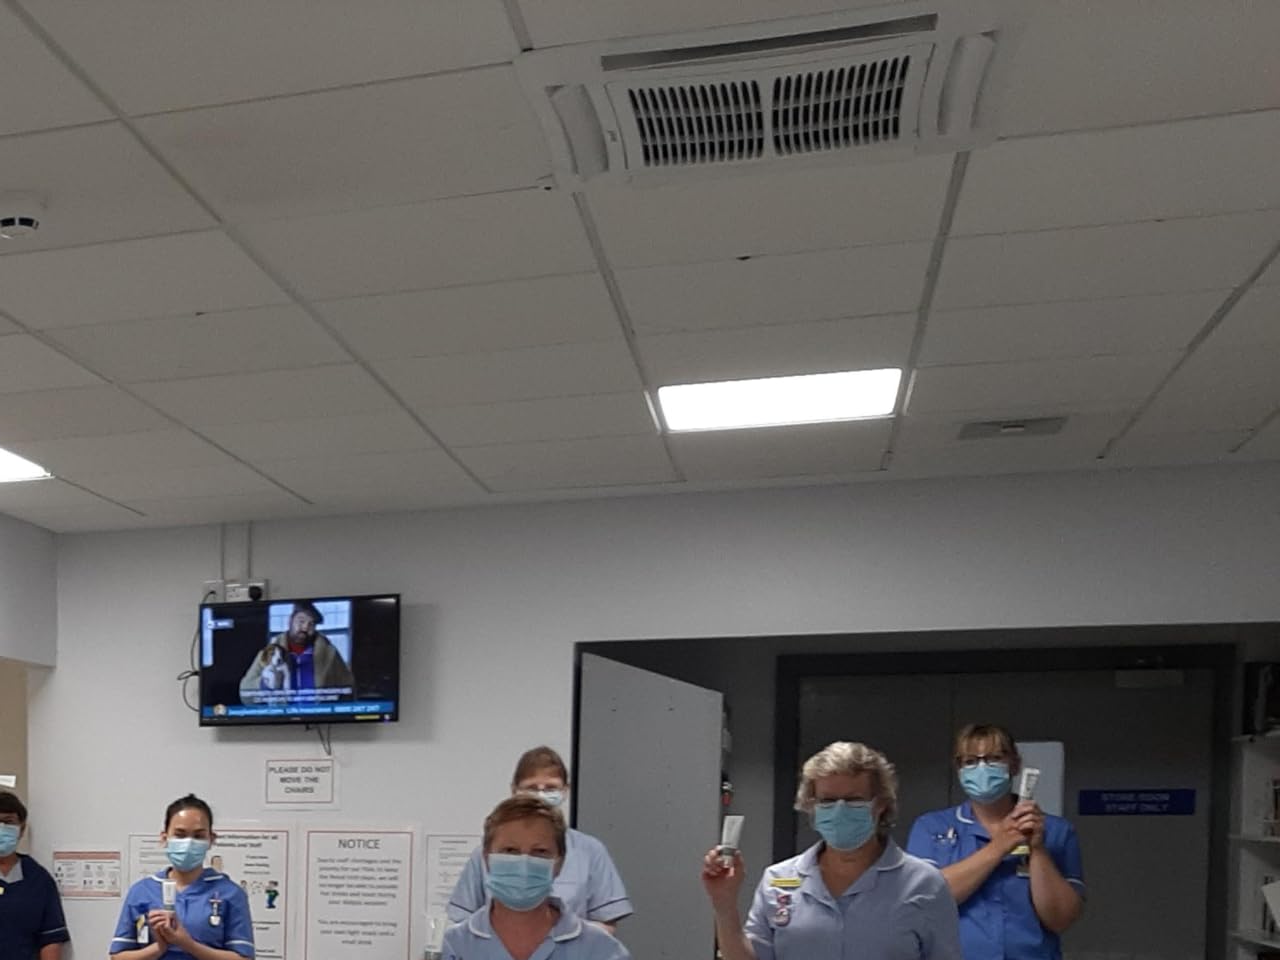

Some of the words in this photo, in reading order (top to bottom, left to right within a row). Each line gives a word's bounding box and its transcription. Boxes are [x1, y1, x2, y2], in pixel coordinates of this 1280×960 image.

[1105, 803, 1137, 812] STAFF
[1140, 803, 1168, 812] ONLY
[338, 839, 381, 849] NOTICE
